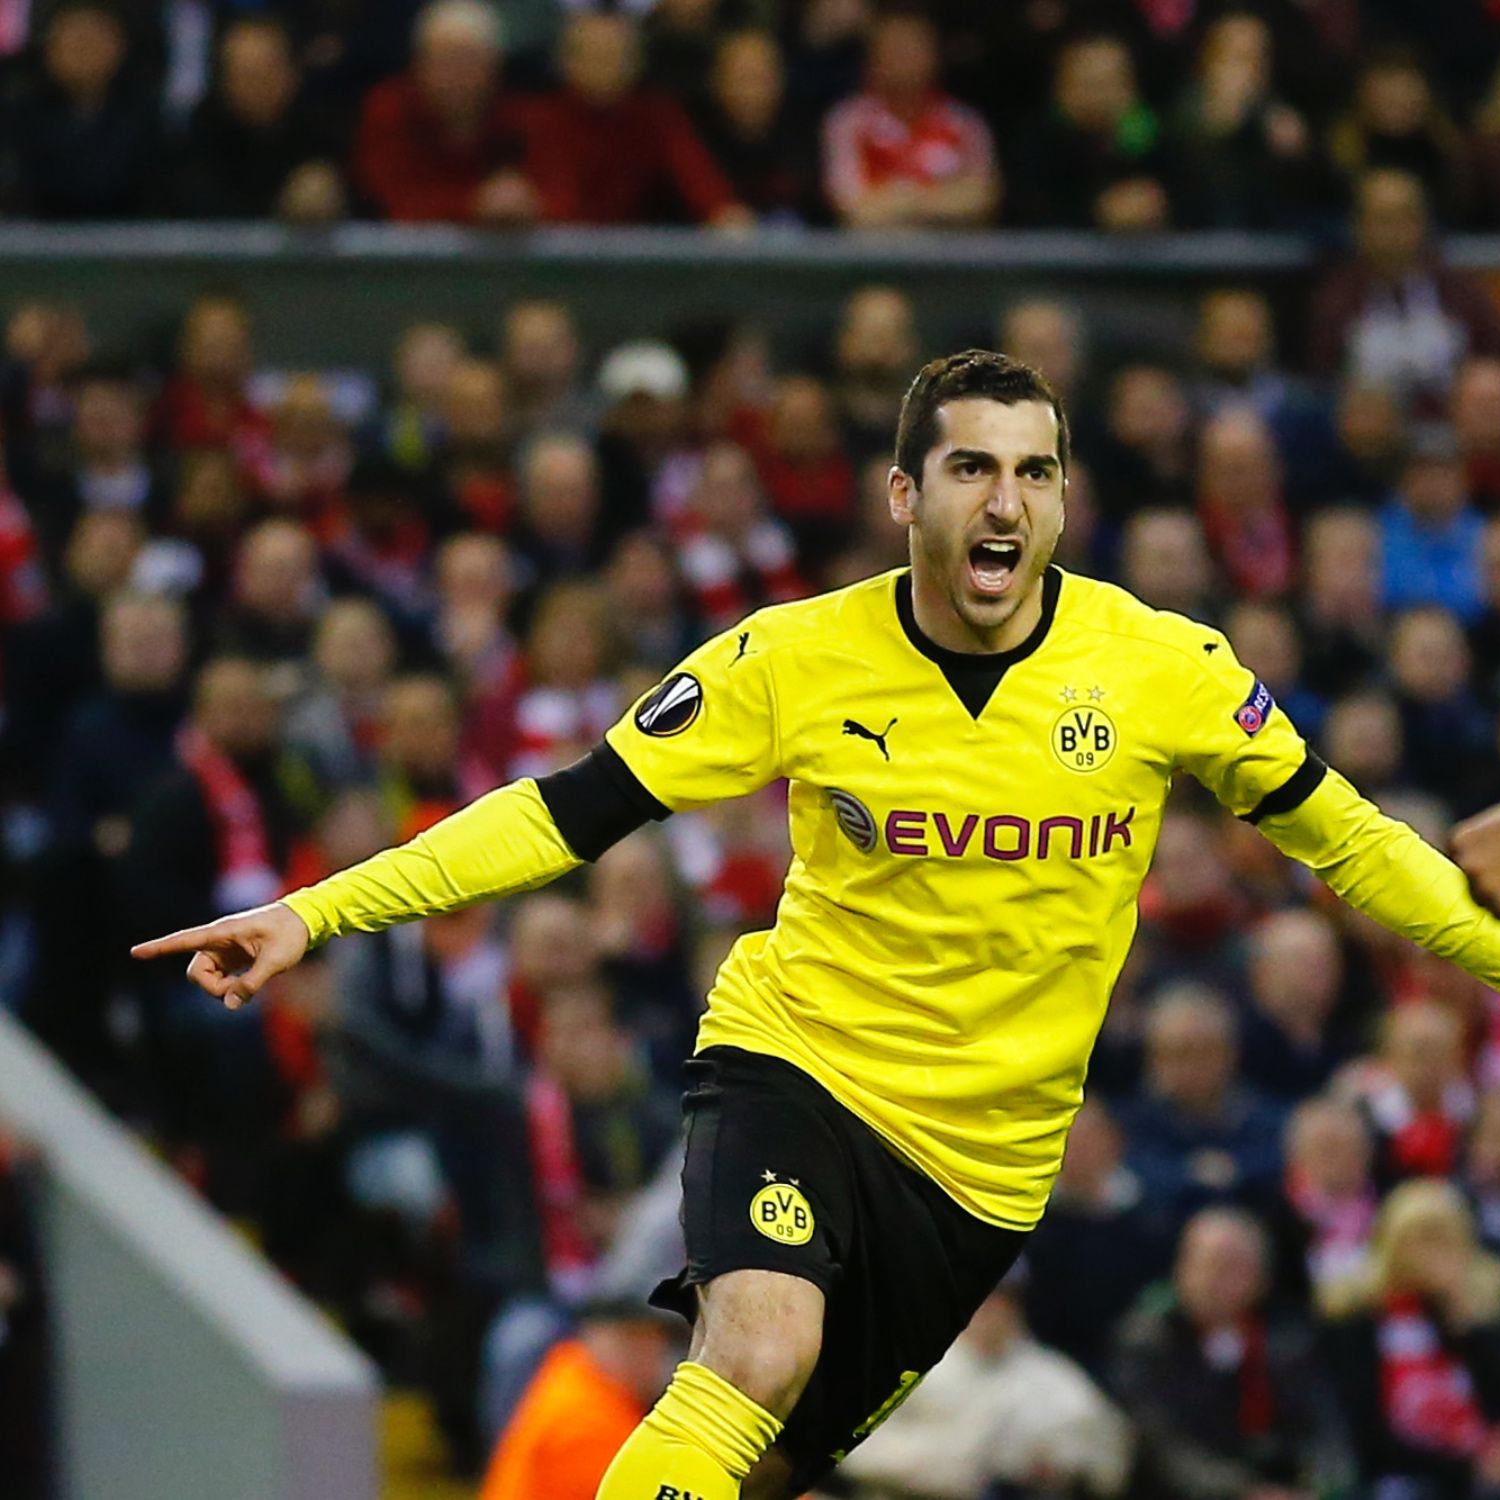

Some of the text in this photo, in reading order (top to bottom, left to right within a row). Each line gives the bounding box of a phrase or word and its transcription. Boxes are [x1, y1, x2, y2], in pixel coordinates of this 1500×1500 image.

[1061, 712, 1110, 752] BVB
[1076, 752, 1094, 766] 09
[885, 806, 1135, 861] EVONIK
[762, 1191, 807, 1230] BVB
[776, 1223, 794, 1238] 09
